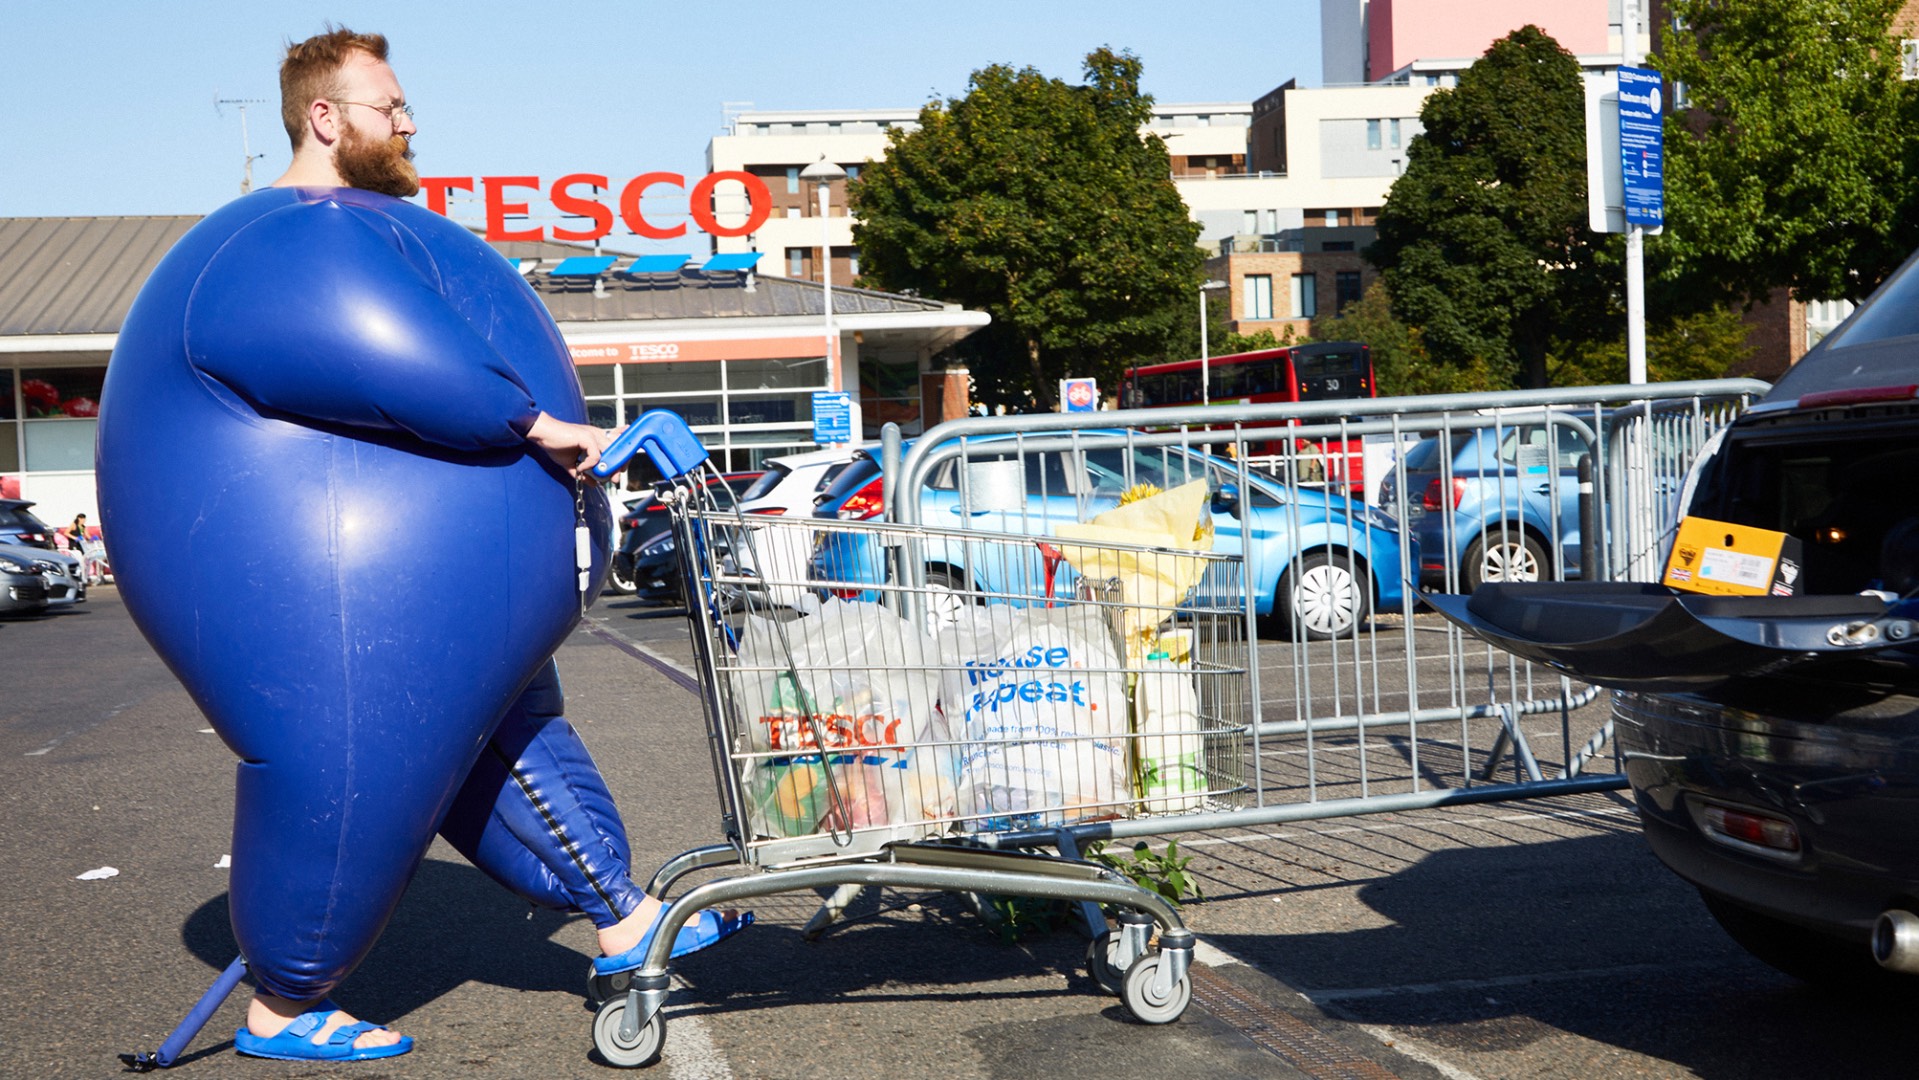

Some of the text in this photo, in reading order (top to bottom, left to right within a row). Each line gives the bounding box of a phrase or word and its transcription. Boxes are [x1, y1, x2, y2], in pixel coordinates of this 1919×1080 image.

[420, 171, 772, 241] TESCO
[571, 344, 679, 357] lcome to TESCO
[1326, 379, 1340, 391] 30
[1011, 725, 1031, 734] from
